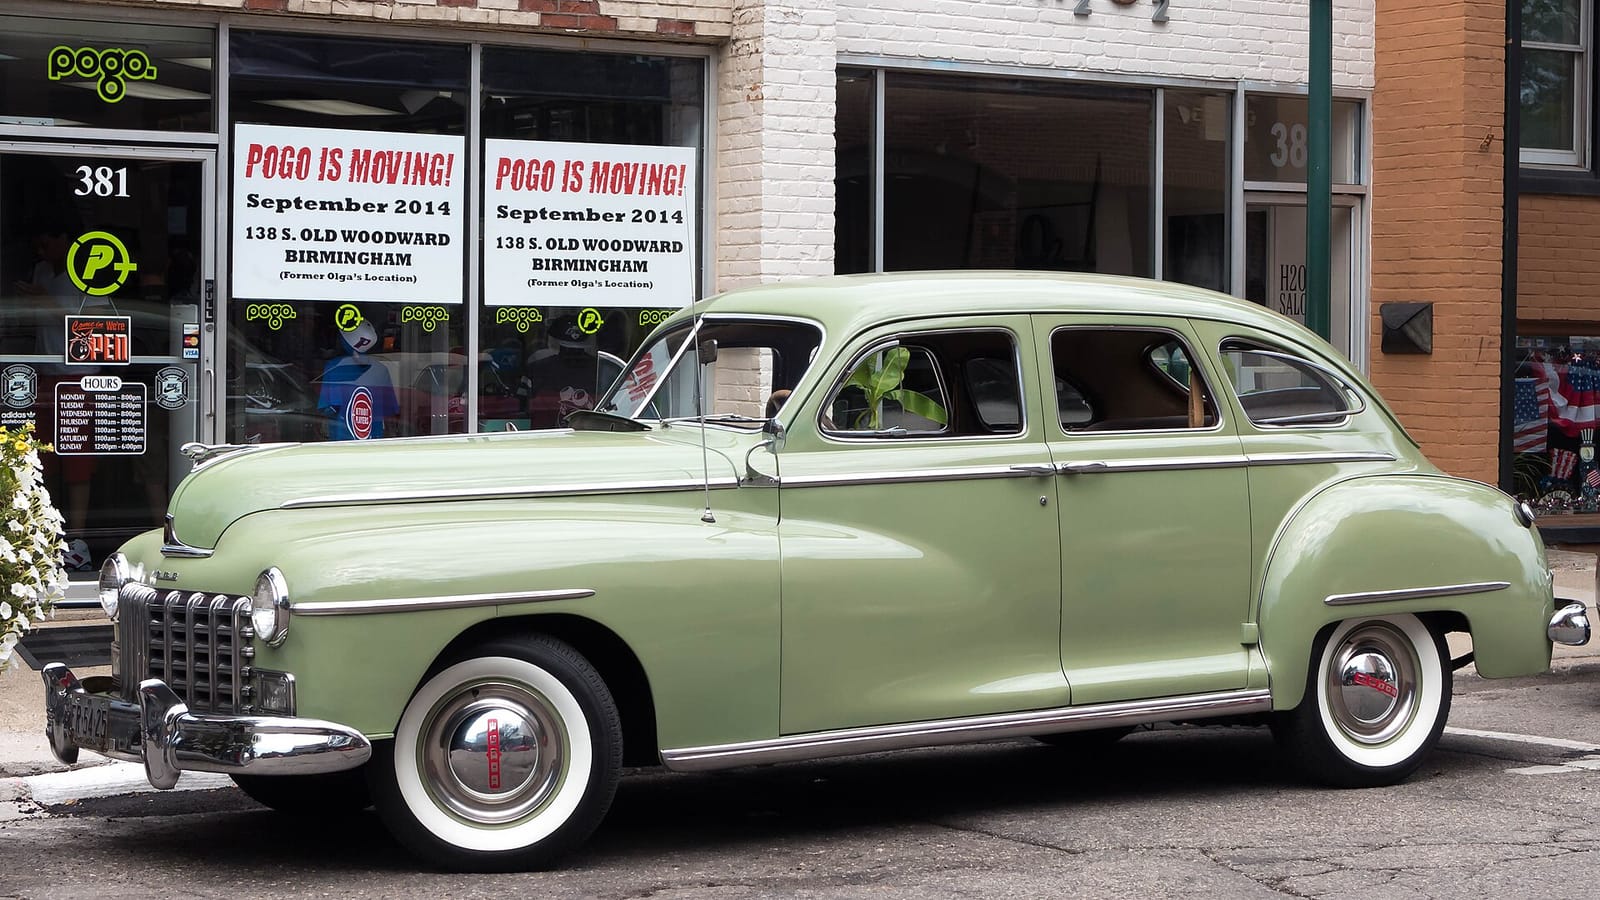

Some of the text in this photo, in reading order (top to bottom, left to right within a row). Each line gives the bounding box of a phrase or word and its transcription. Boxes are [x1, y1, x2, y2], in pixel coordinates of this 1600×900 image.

[1270, 122, 1307, 168] 38
[246, 143, 455, 187] POGO IS MOVING!
[74, 165, 130, 198] 381
[495, 157, 686, 197] POGO IS MOVING!
[246, 193, 451, 216] September 2014
[496, 205, 683, 224] September 2014
[245, 226, 451, 246] 138 S. OLD WOODWARD
[496, 236, 683, 253] 138 S. OLD WOODWARD
[284, 249, 412, 266] BIRMINGHAM
[532, 258, 648, 273] BIRMINGHAM
[279, 271, 417, 283] (Former Olga's Location)
[527, 279, 653, 289] (Former Olga's Location)
[205, 283, 213, 319] PULL
[1280, 292, 1306, 315] SALO
[69, 333, 128, 361] OPEN
[84, 378, 119, 389] HOURS
[1, 411, 26, 419] adidas
